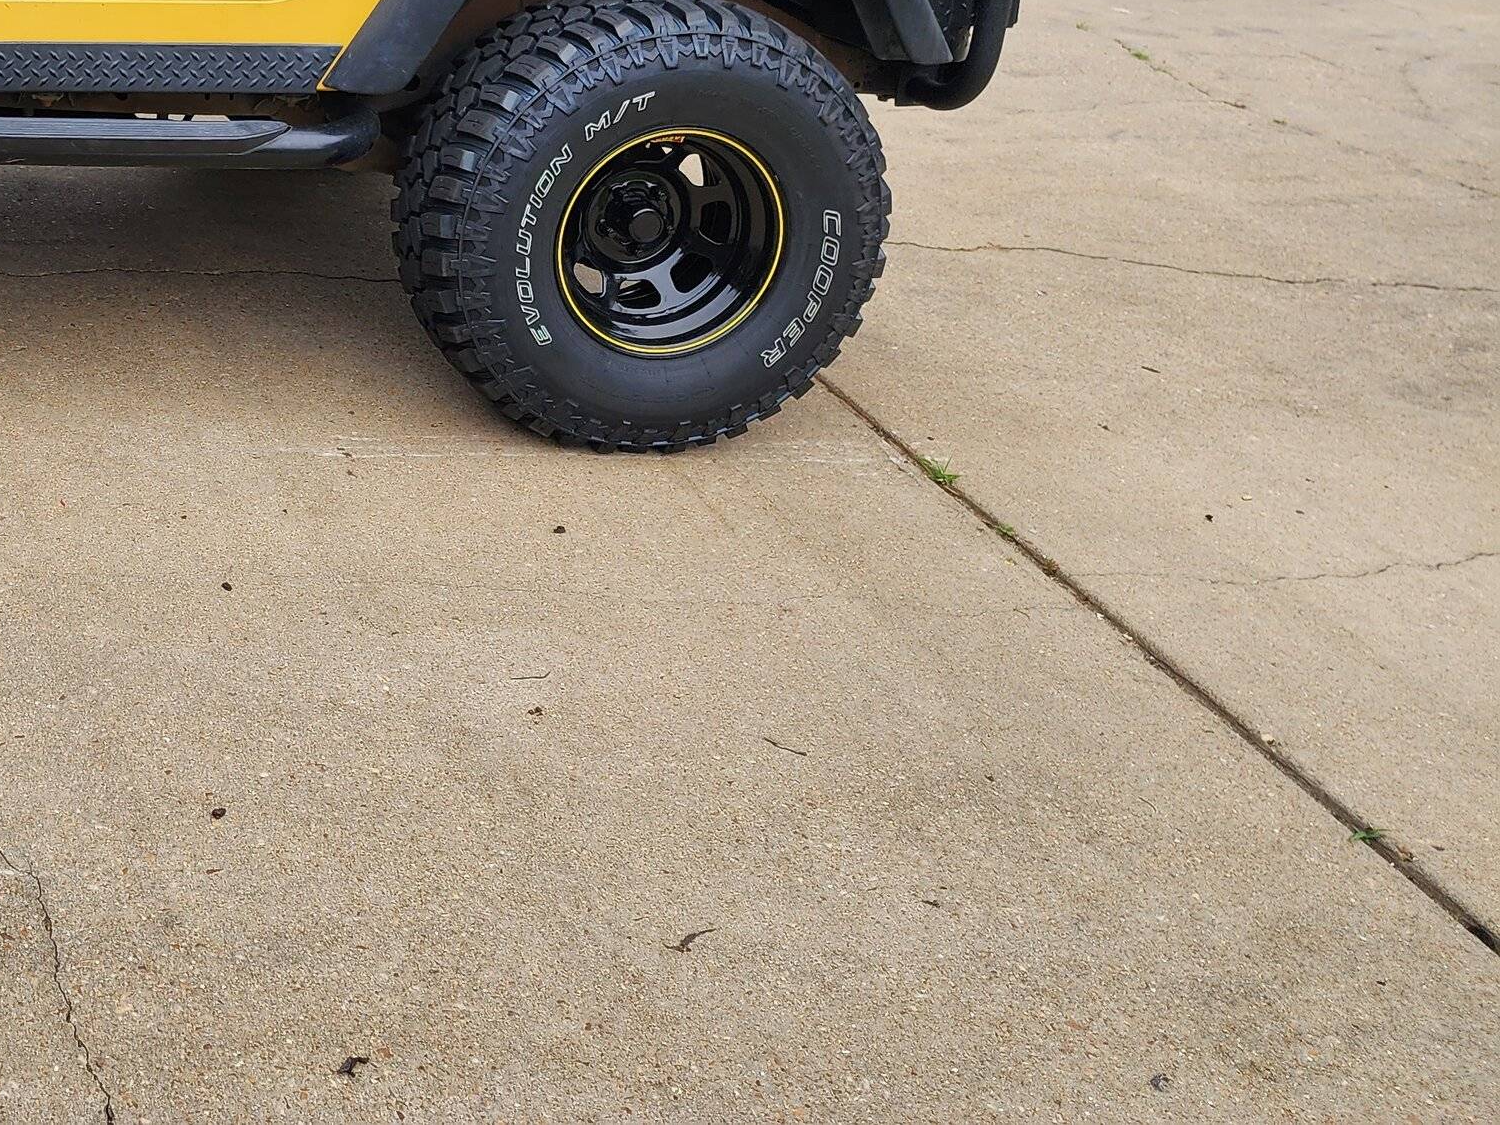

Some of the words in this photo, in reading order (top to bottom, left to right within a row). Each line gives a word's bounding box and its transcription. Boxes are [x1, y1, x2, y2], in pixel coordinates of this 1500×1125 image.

[512, 143, 573, 347] EVOLUTION
[584, 91, 656, 141] M/T
[760, 209, 843, 369] COOPER
